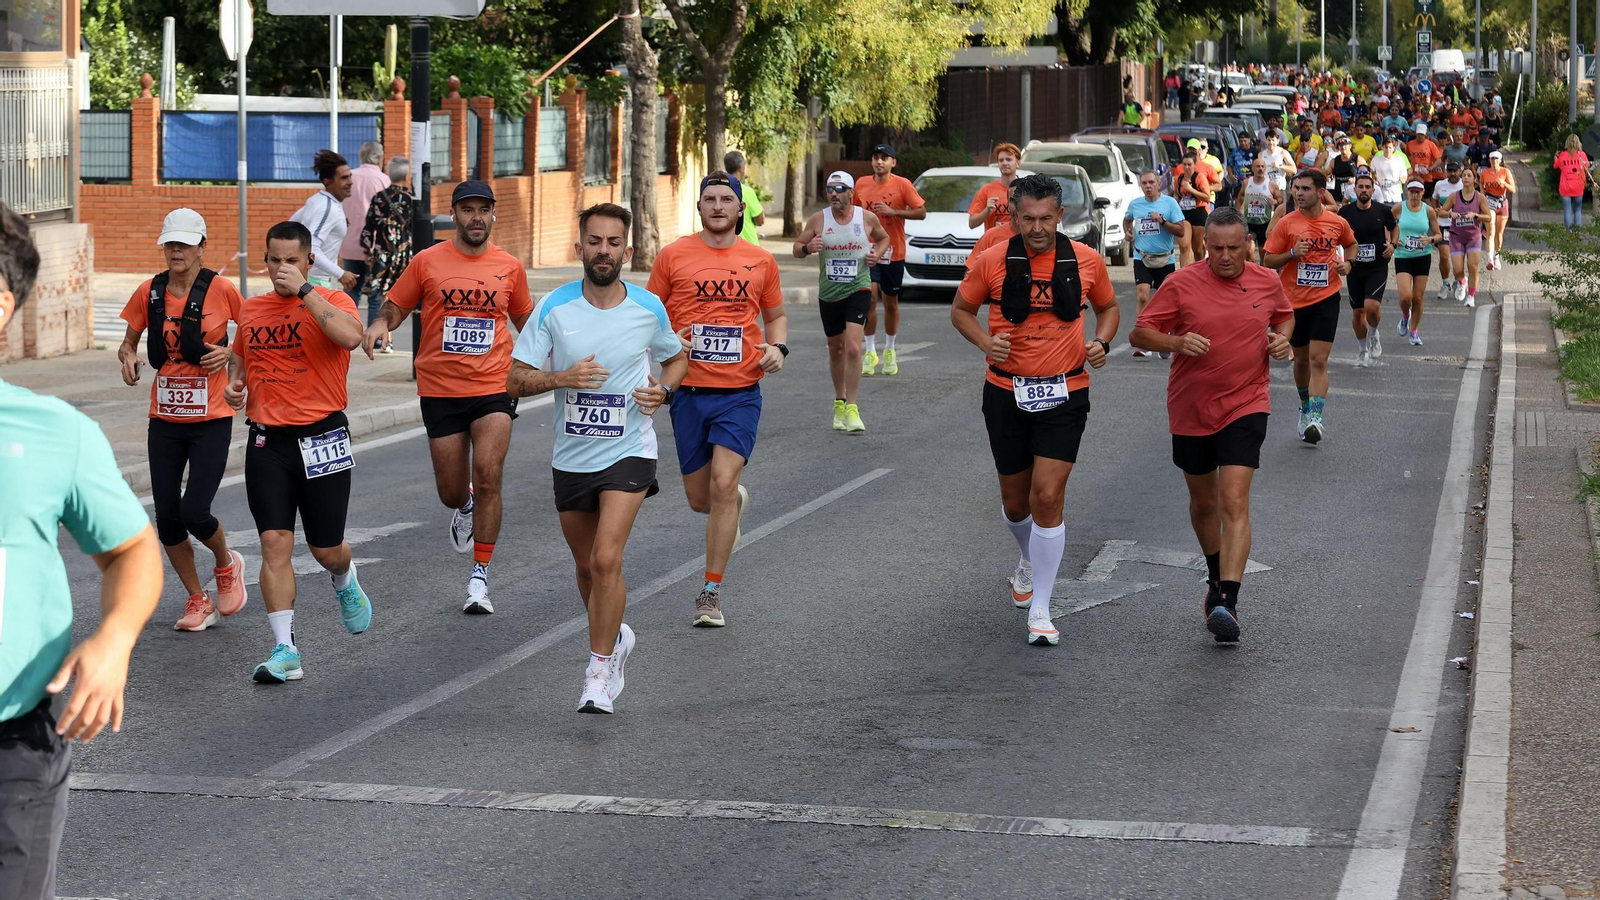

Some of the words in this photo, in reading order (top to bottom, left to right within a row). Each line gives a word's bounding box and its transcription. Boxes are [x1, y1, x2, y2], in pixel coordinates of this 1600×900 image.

[825, 241, 863, 251] maratón
[930, 254, 952, 264] 9393
[833, 266, 850, 275] 592
[1305, 270, 1322, 280] 977
[694, 279, 750, 298] XXIX
[441, 288, 498, 307] XXIX
[249, 321, 302, 344] XXIX
[452, 329, 487, 343] 1089
[703, 338, 730, 351] 917
[168, 390, 194, 404] 332
[1027, 385, 1055, 399] 882
[578, 407, 611, 424] 760
[312, 442, 346, 462] 1115
